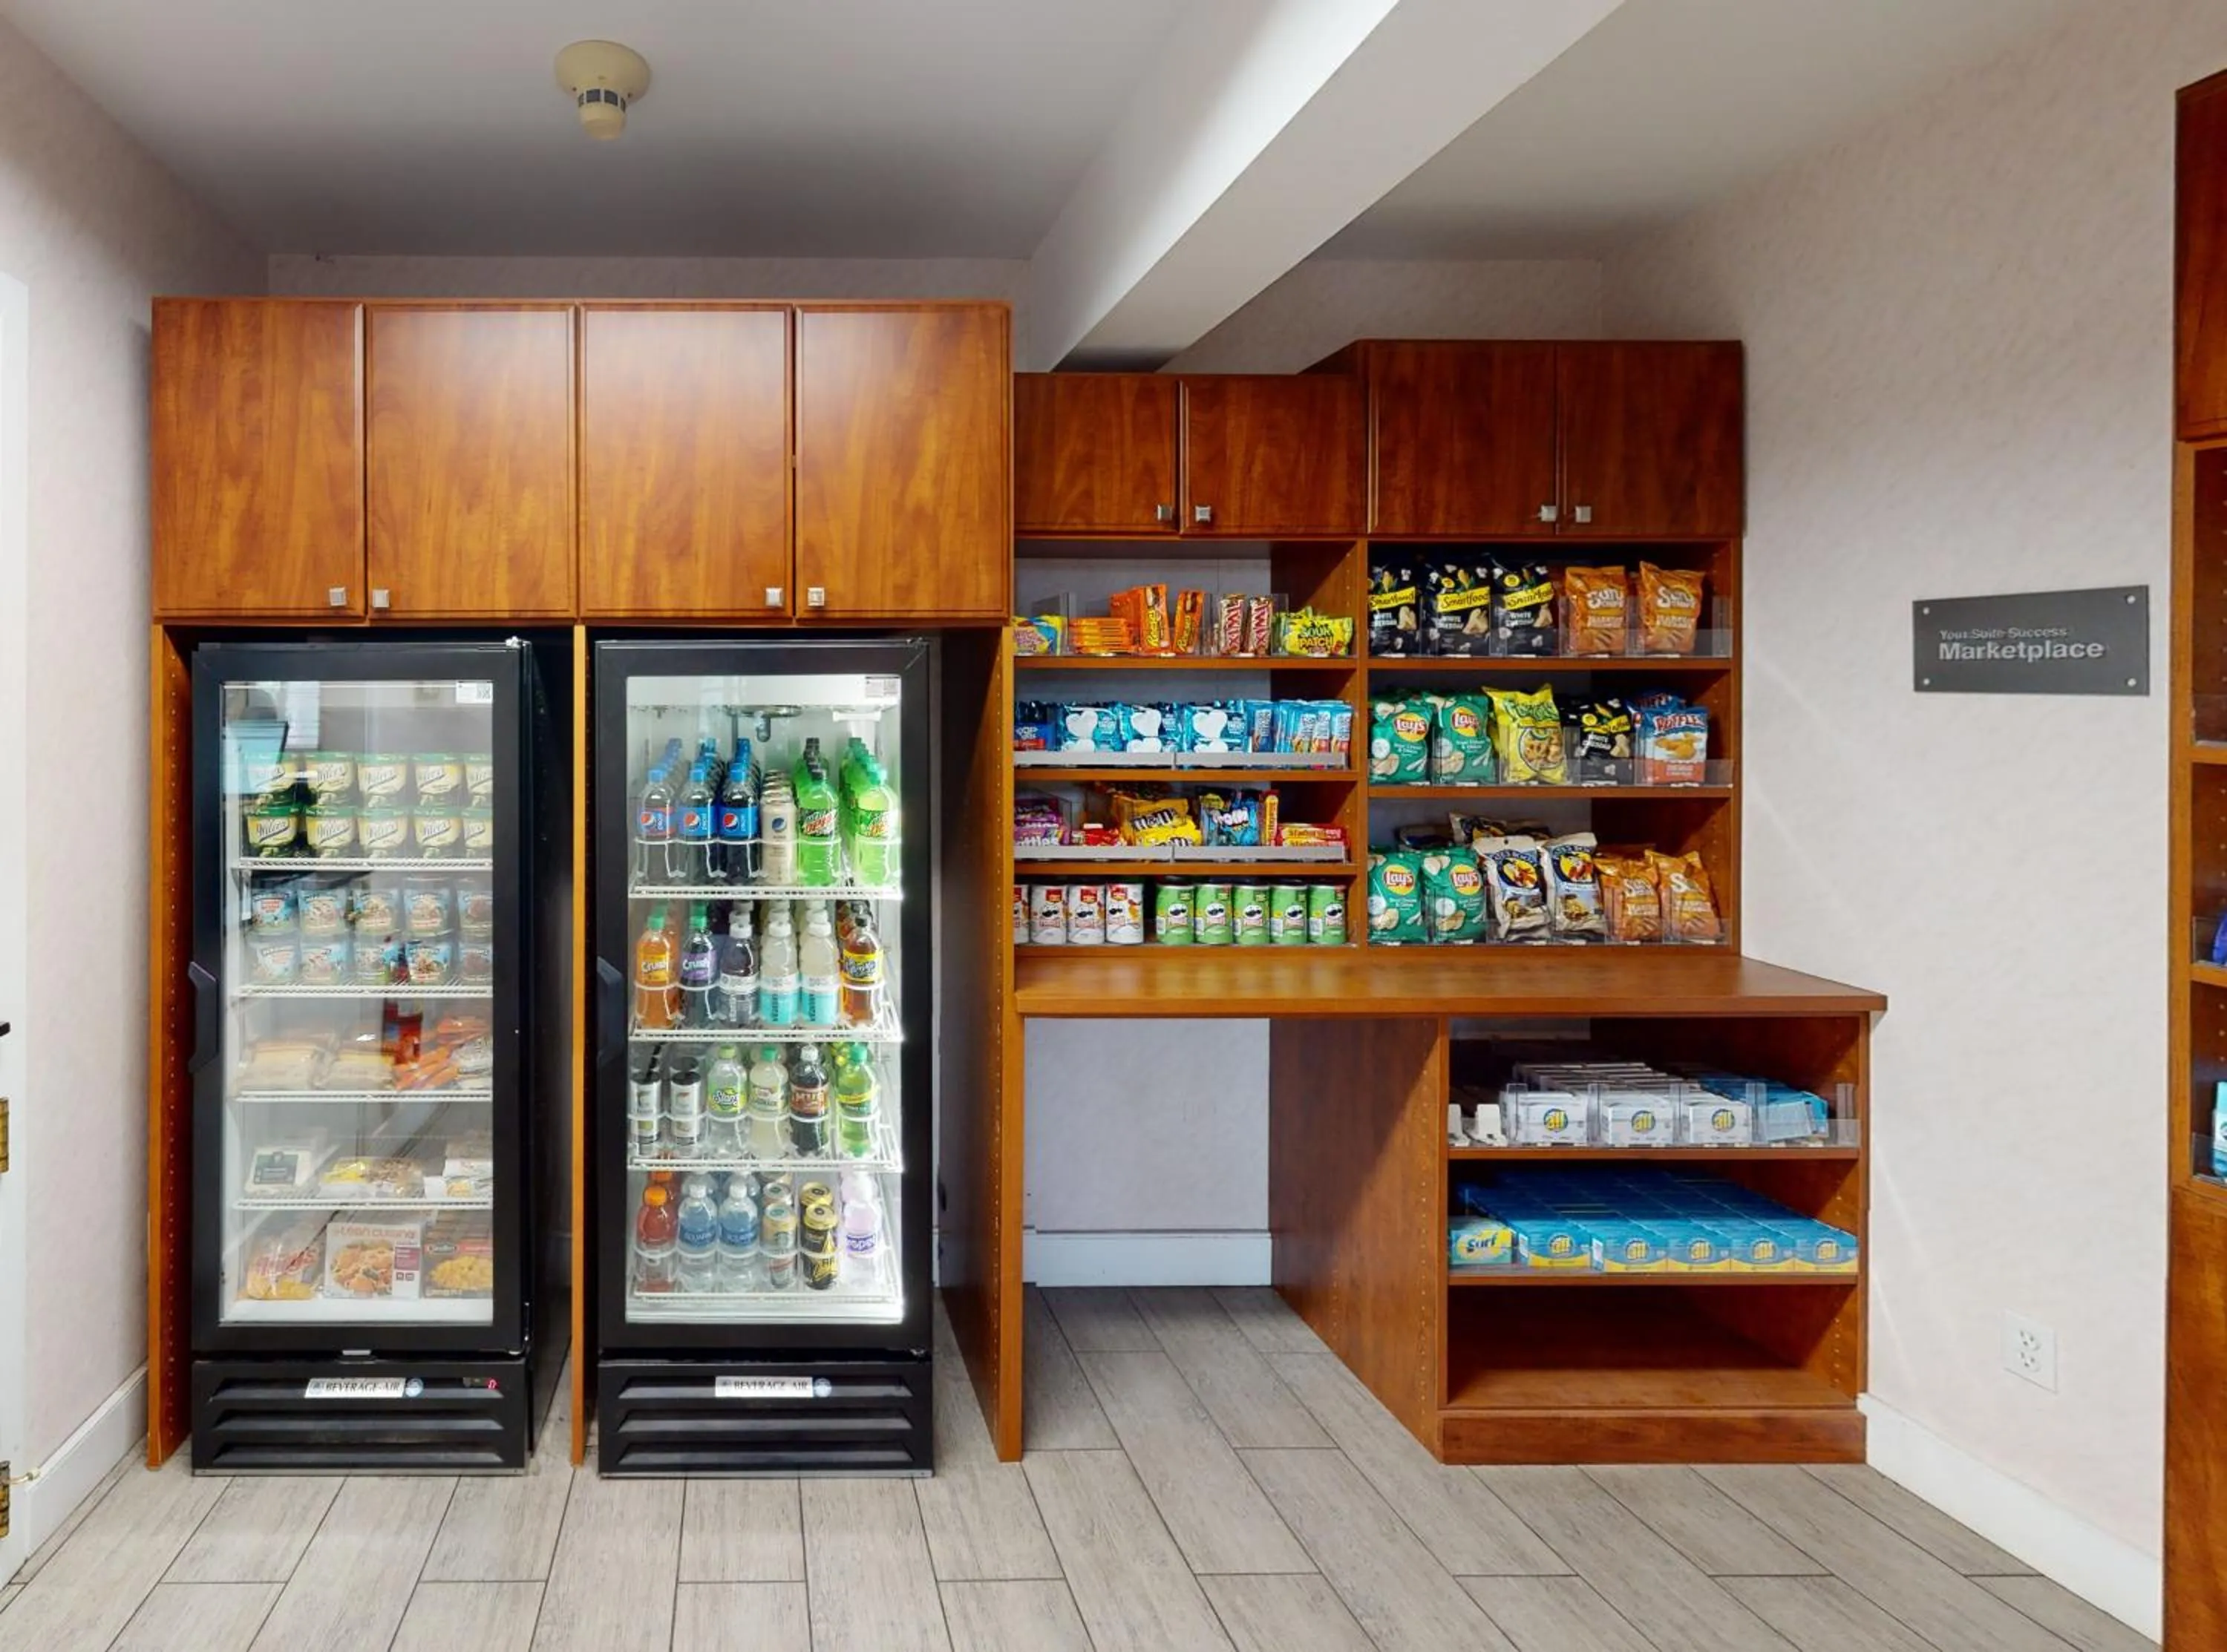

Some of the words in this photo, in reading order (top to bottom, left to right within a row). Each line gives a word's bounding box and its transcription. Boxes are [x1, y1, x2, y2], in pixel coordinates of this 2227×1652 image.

[1298, 636, 1333, 649] PATCH
[1940, 630, 1967, 640] Your
[2007, 627, 2067, 637] Success
[1938, 640, 2104, 662] Marketplace
[1546, 1111, 1568, 1130] all
[1633, 1112, 1655, 1132] all
[1714, 1111, 1735, 1129] all
[1467, 1232, 1497, 1252] Surf
[1549, 1236, 1571, 1254] all
[1626, 1243, 1648, 1261] all
